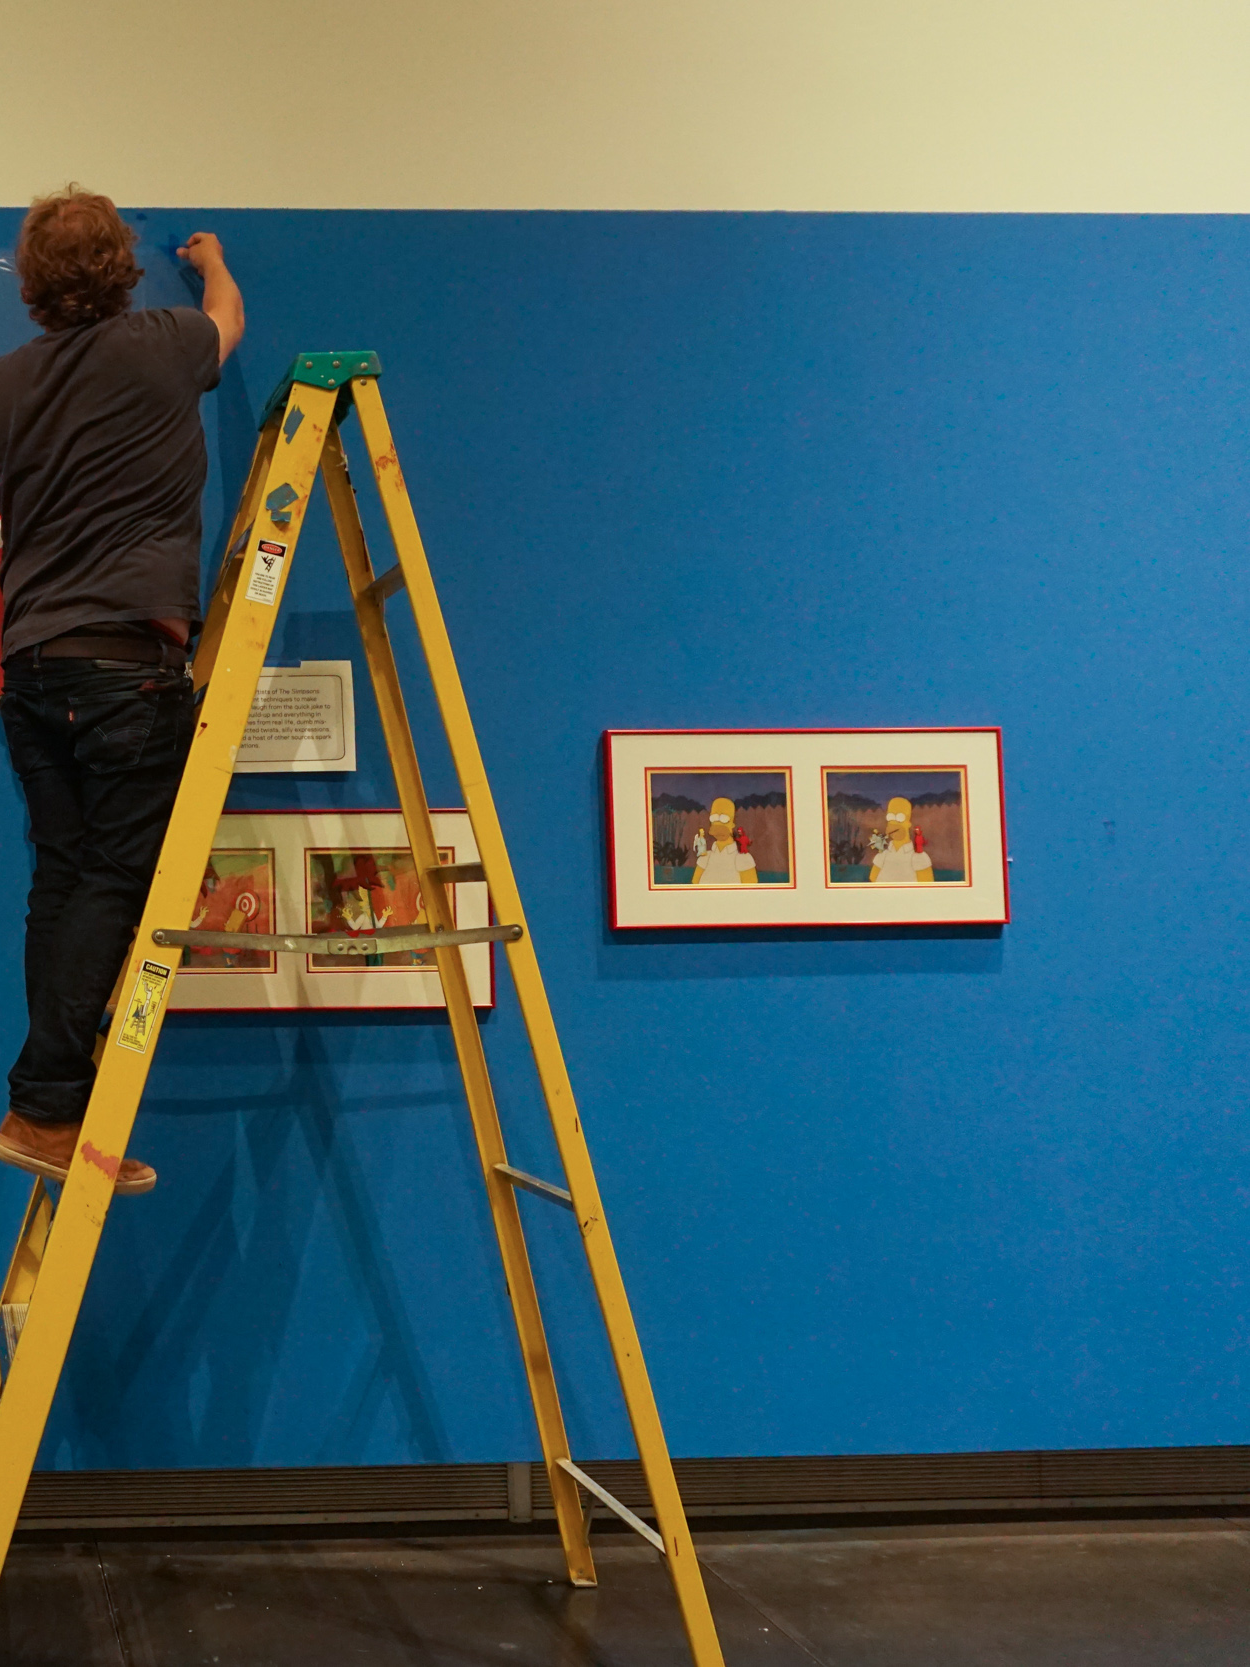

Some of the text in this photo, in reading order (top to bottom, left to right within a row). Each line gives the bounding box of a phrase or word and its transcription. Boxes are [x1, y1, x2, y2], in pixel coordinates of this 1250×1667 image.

[260, 696, 293, 704] techniques
[283, 711, 315, 719] everything
[145, 963, 168, 976] CAUTION
